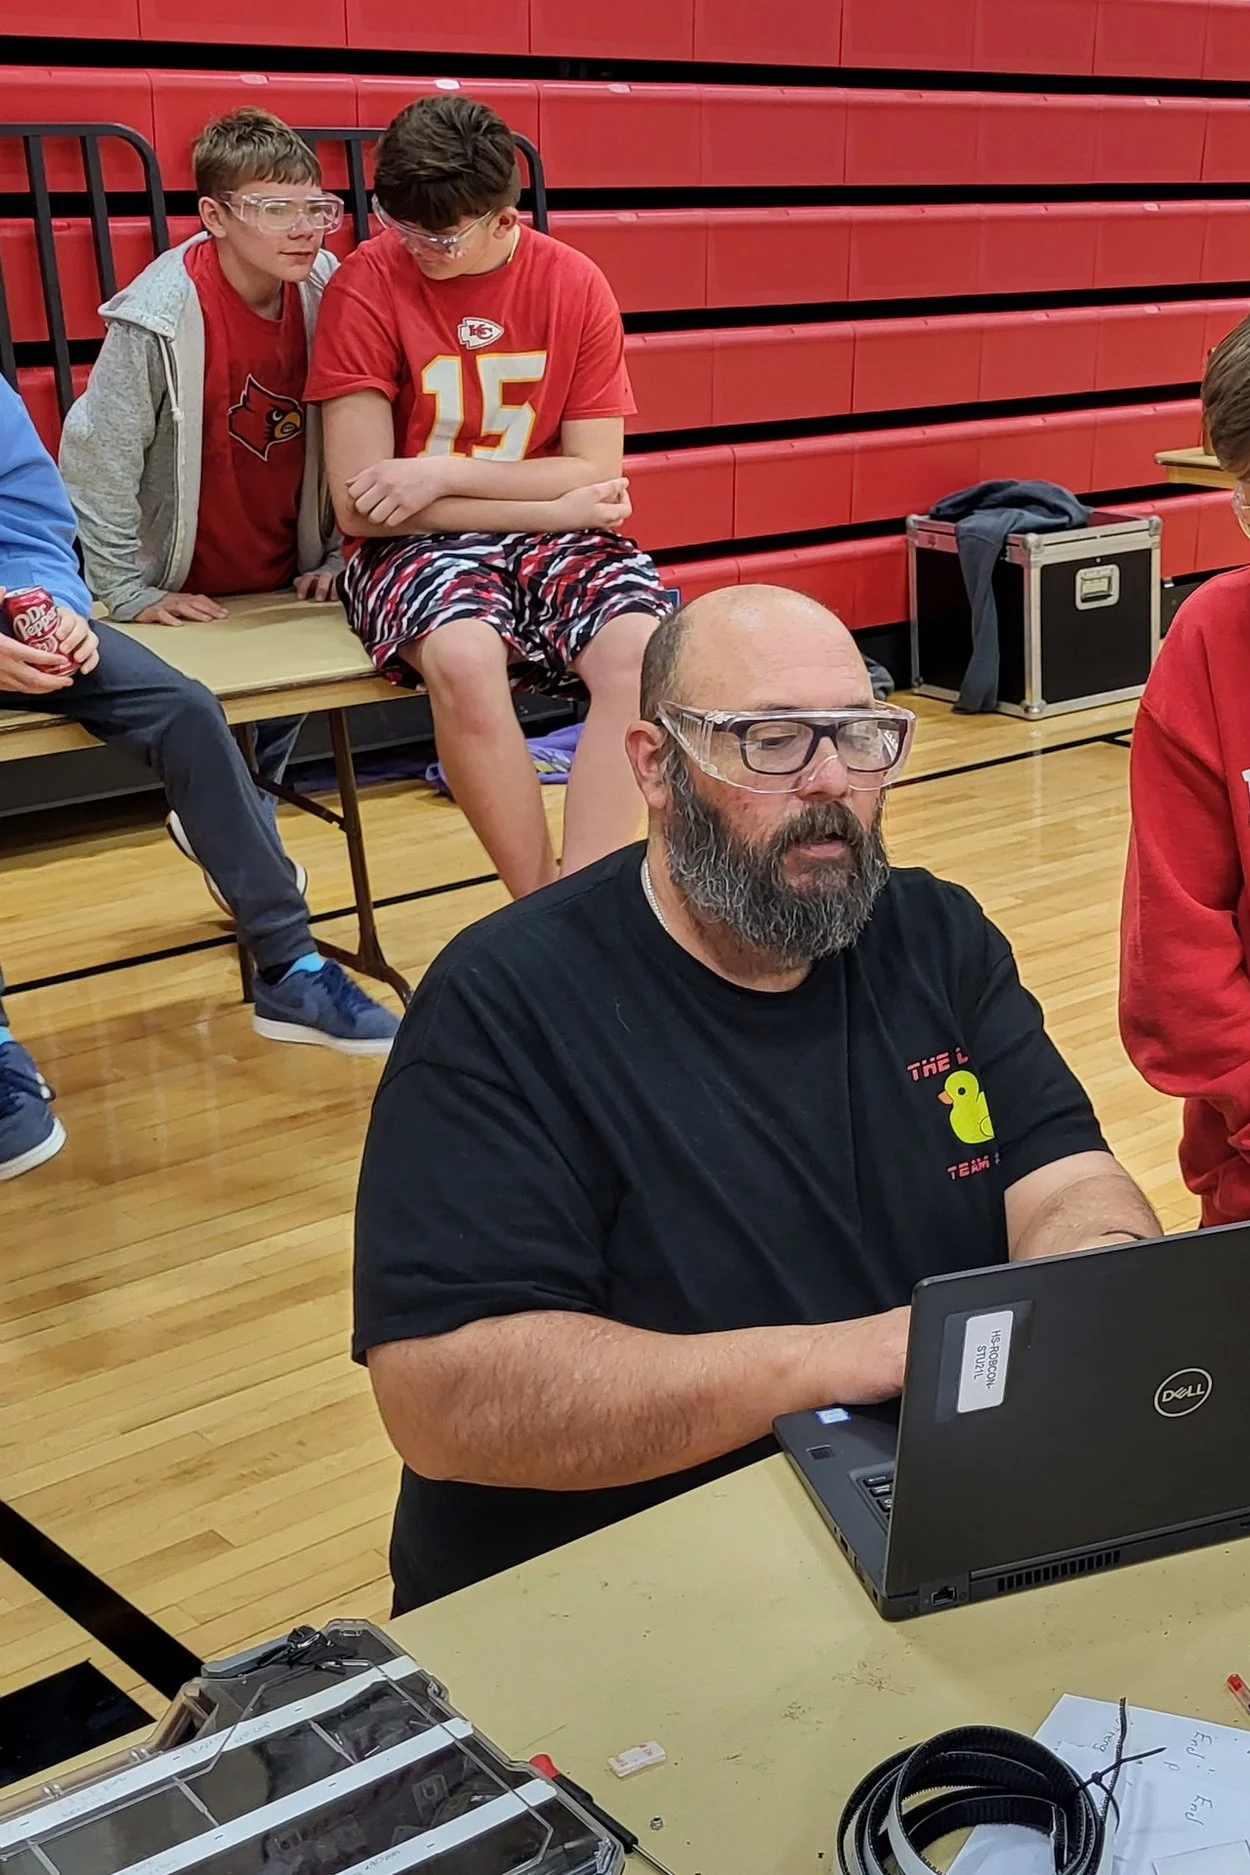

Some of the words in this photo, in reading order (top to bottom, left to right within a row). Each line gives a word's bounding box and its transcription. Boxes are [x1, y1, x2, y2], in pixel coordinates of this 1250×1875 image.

[468, 323, 493, 340] KC
[416, 350, 548, 461] 15
[25, 603, 47, 623] Dr
[906, 1051, 951, 1082] THE
[947, 1154, 991, 1181] TEAM
[985, 1328, 1002, 1390] HS-ROBCON-
[1161, 1383, 1206, 1403] DELL
[1184, 1795, 1213, 1826] End
